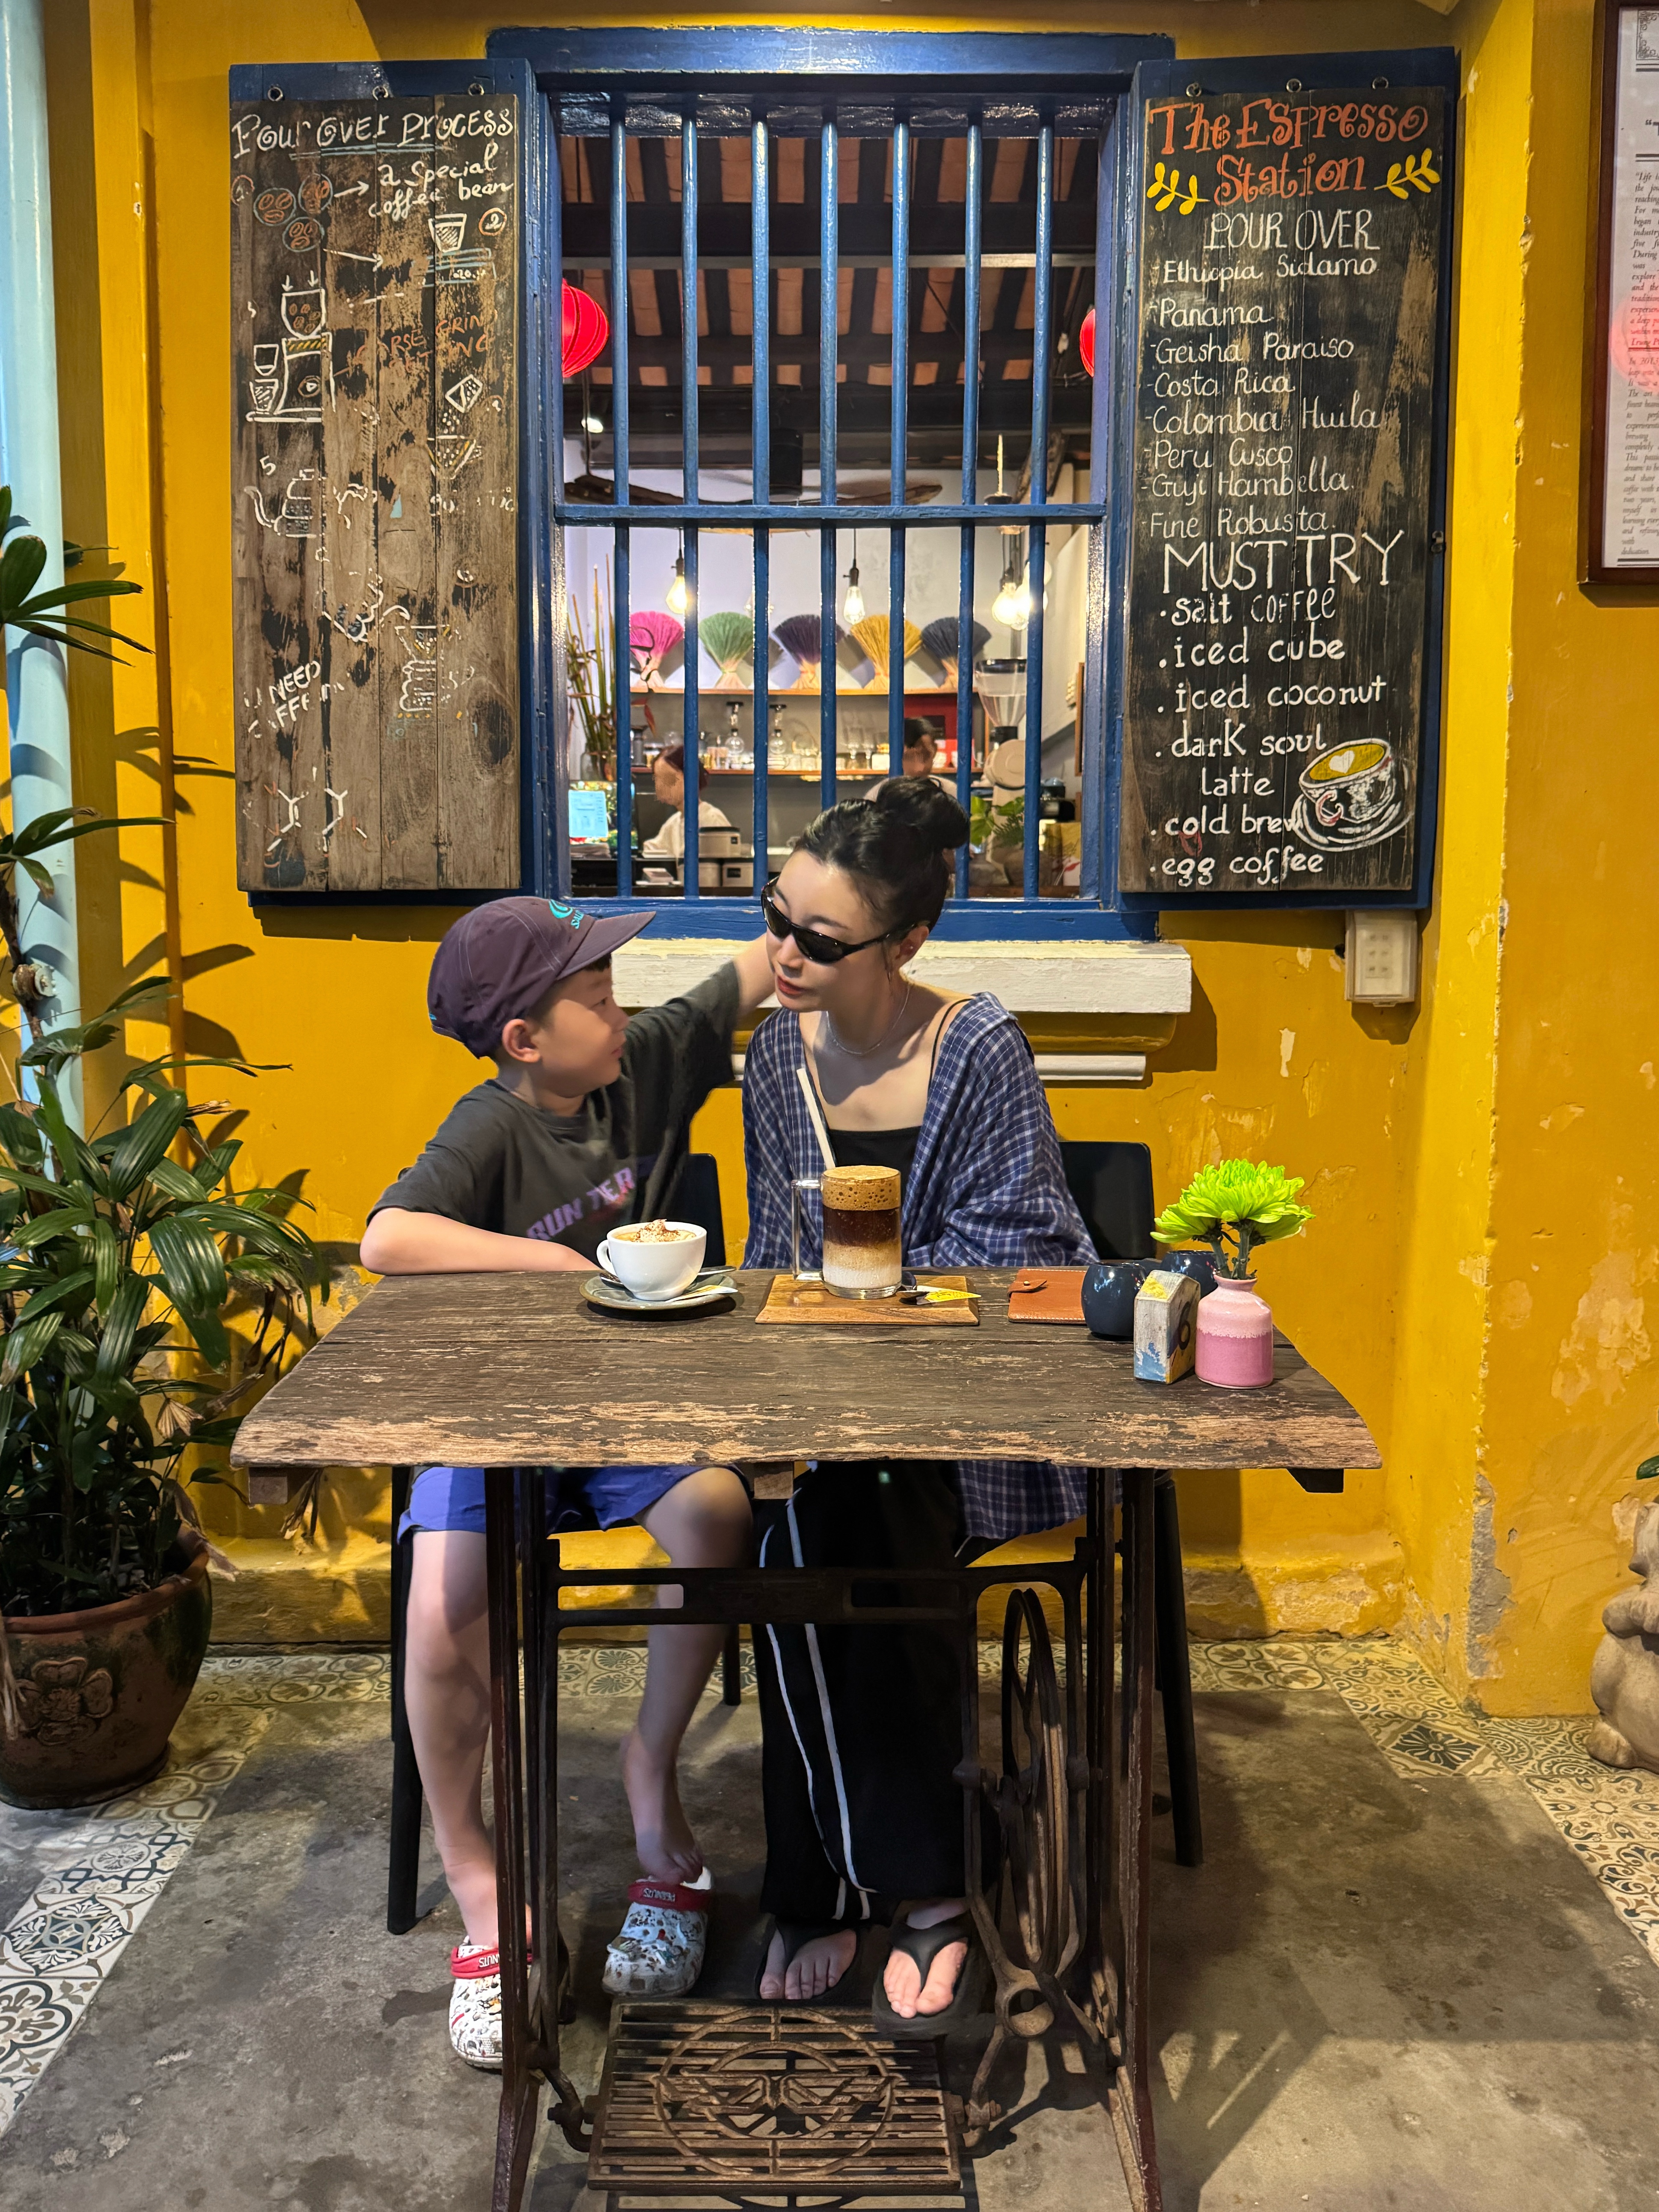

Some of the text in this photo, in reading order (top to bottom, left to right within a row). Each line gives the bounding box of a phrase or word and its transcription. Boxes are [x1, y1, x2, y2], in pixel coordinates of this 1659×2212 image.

[1150, 103, 1231, 155] The
[458, 178, 514, 201] bean
[1214, 152, 1367, 206] Station
[1204, 208, 1380, 251] POUR OVER
[1276, 252, 1378, 278] Sidamo
[1160, 298, 1274, 328] Panama
[1155, 331, 1354, 364] Geisha Paraiso
[1155, 367, 1296, 398] Costa Rica
[1152, 390, 1382, 435] Colombia Huila
[1155, 437, 1293, 469] Peru Cusco
[1152, 473, 1207, 506] Guji
[1150, 512, 1200, 538] Fine
[1163, 529, 1404, 594] MUST TRY
[1174, 622, 1346, 668] iced cube
[1175, 674, 1387, 713] iced coconut
[1260, 722, 1327, 756] soul
[1165, 805, 1230, 836] cold
[1161, 845, 1324, 887] egg coffee
